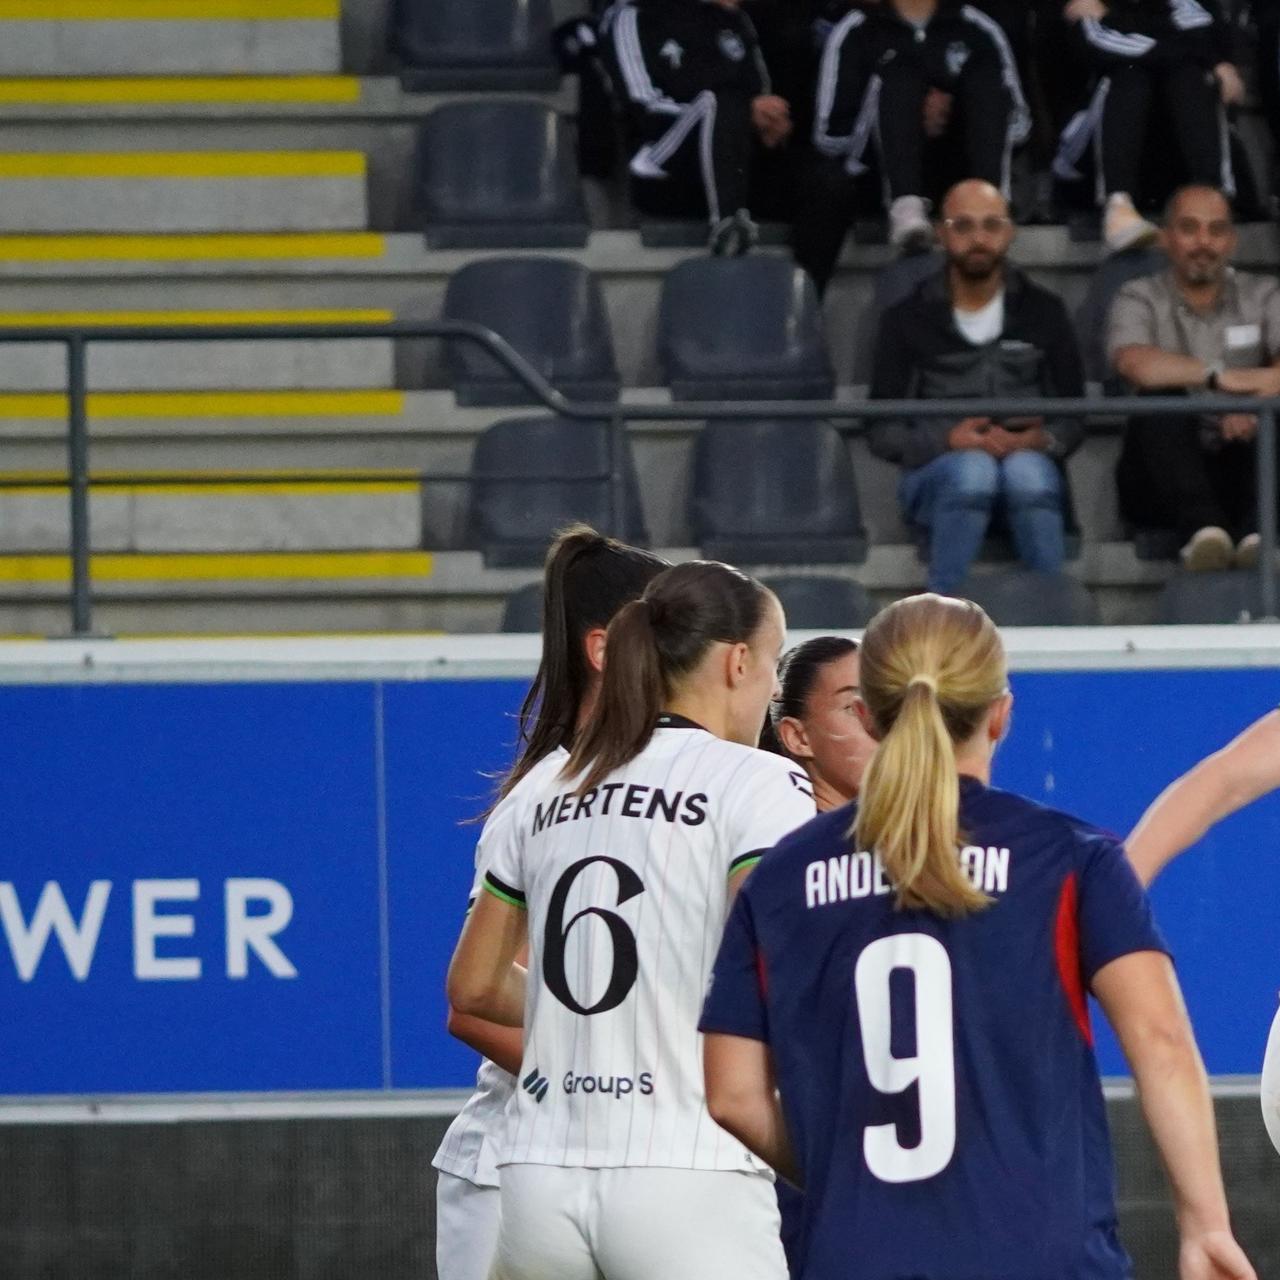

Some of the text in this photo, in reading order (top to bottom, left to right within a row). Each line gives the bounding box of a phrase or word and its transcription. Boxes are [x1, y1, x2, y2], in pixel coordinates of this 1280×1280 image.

[532, 782, 708, 837] MERTENS
[804, 845, 1010, 909] ANDEON
[0, 876, 299, 982] WER
[543, 855, 645, 1016] 6
[563, 1071, 654, 1099] Group S
[855, 932, 957, 1184] 9
